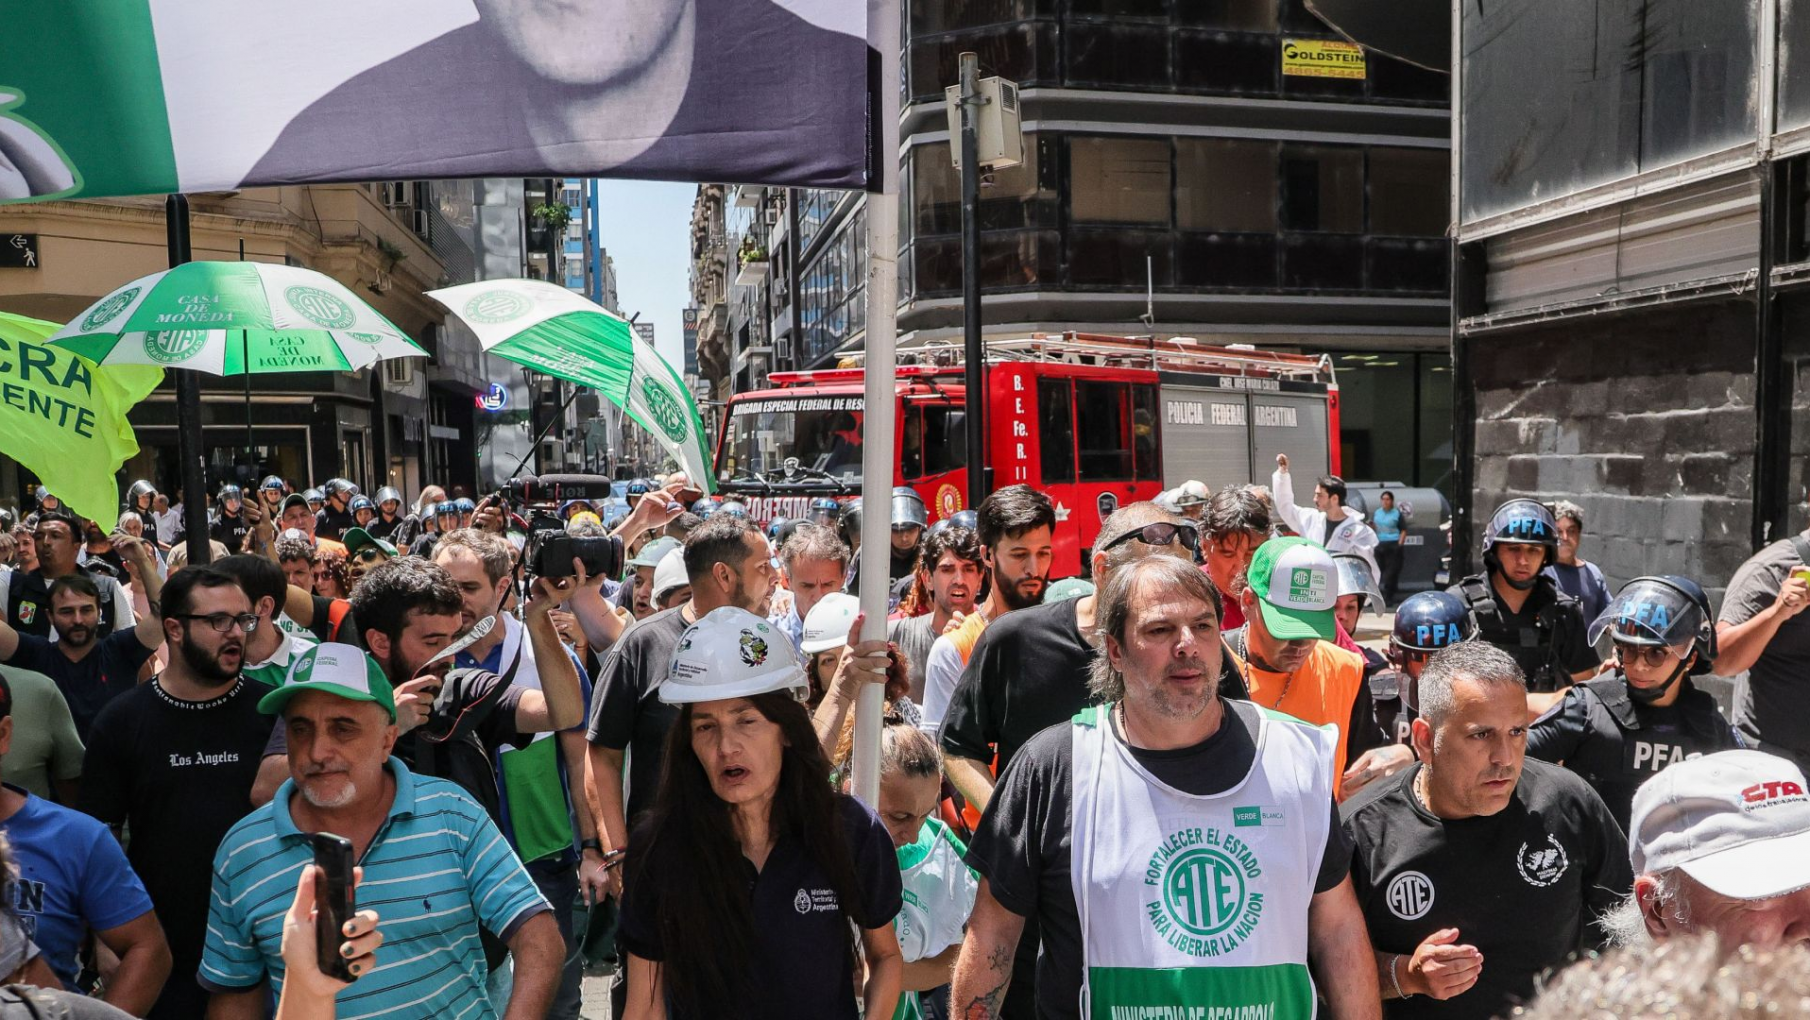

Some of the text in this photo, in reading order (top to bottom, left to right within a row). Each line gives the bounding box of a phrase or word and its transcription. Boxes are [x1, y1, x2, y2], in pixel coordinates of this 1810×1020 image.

[1284, 43, 1365, 62] GOLDSTEIN
[178, 295, 220, 304] CASA
[184, 304, 210, 313] DE
[155, 313, 234, 323] MONEDA
[1013, 374, 1025, 391] B.
[3, 382, 95, 439] ENTE
[732, 403, 762, 415] BRIGADA
[763, 400, 797, 412] ESPECIAL
[798, 398, 829, 411] FEDERAL
[832, 398, 844, 410] DE
[1015, 397, 1025, 414] E.
[1167, 401, 1298, 427] POLICIA FEDERAL ARGENTINA
[1013, 420, 1029, 437] Fe.
[1016, 443, 1027, 460] R.
[632, 484, 646, 492] PFA
[1508, 517, 1545, 536] PFA
[1619, 601, 1669, 629] PFA
[1416, 623, 1461, 647] PFA
[169, 751, 239, 767] Los Angeles
[1633, 741, 1684, 771] PFA
[1741, 781, 1804, 803] CTA
[1236, 812, 1284, 821] VERDE BLANCA
[1144, 827, 1262, 886] FORTALECER EL ESTADO
[1171, 856, 1235, 928] ATE
[1391, 876, 1429, 915] ATE
[812, 903, 839, 912] Argentina
[1146, 892, 1264, 957] PARA LIBERAR LA NACION
